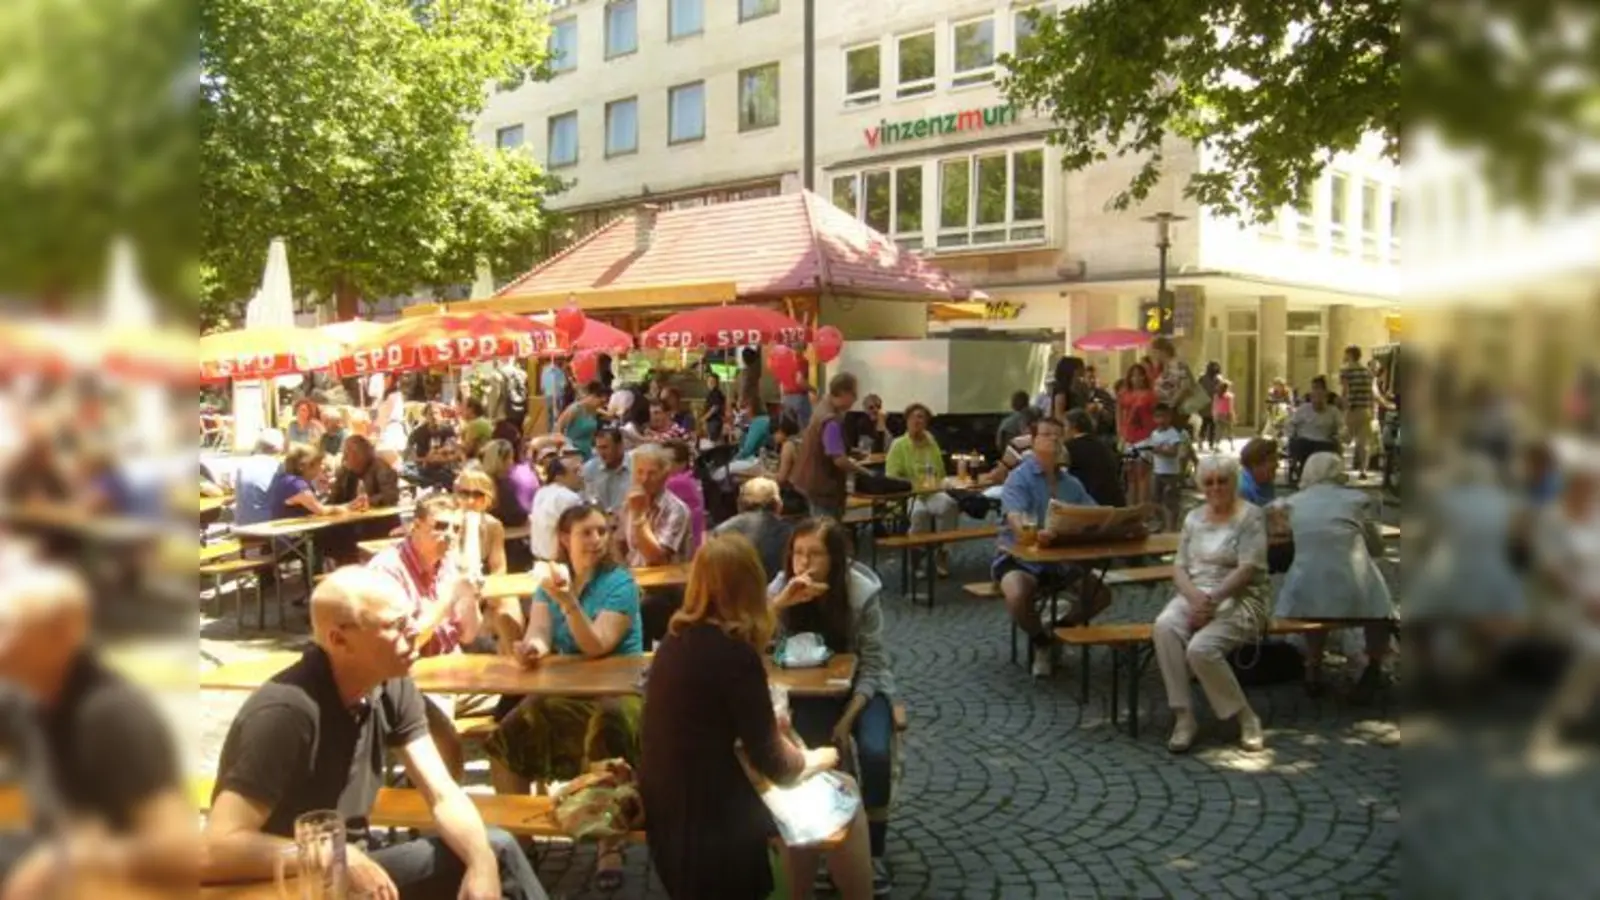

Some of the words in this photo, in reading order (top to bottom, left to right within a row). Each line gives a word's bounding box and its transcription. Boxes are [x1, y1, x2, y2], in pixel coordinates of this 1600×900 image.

[657, 331, 692, 348] SPD
[717, 329, 761, 346] SPD
[780, 327, 805, 344] SPD
[353, 344, 402, 371] SPD
[436, 335, 498, 361] SPD
[217, 353, 275, 377] SPD
